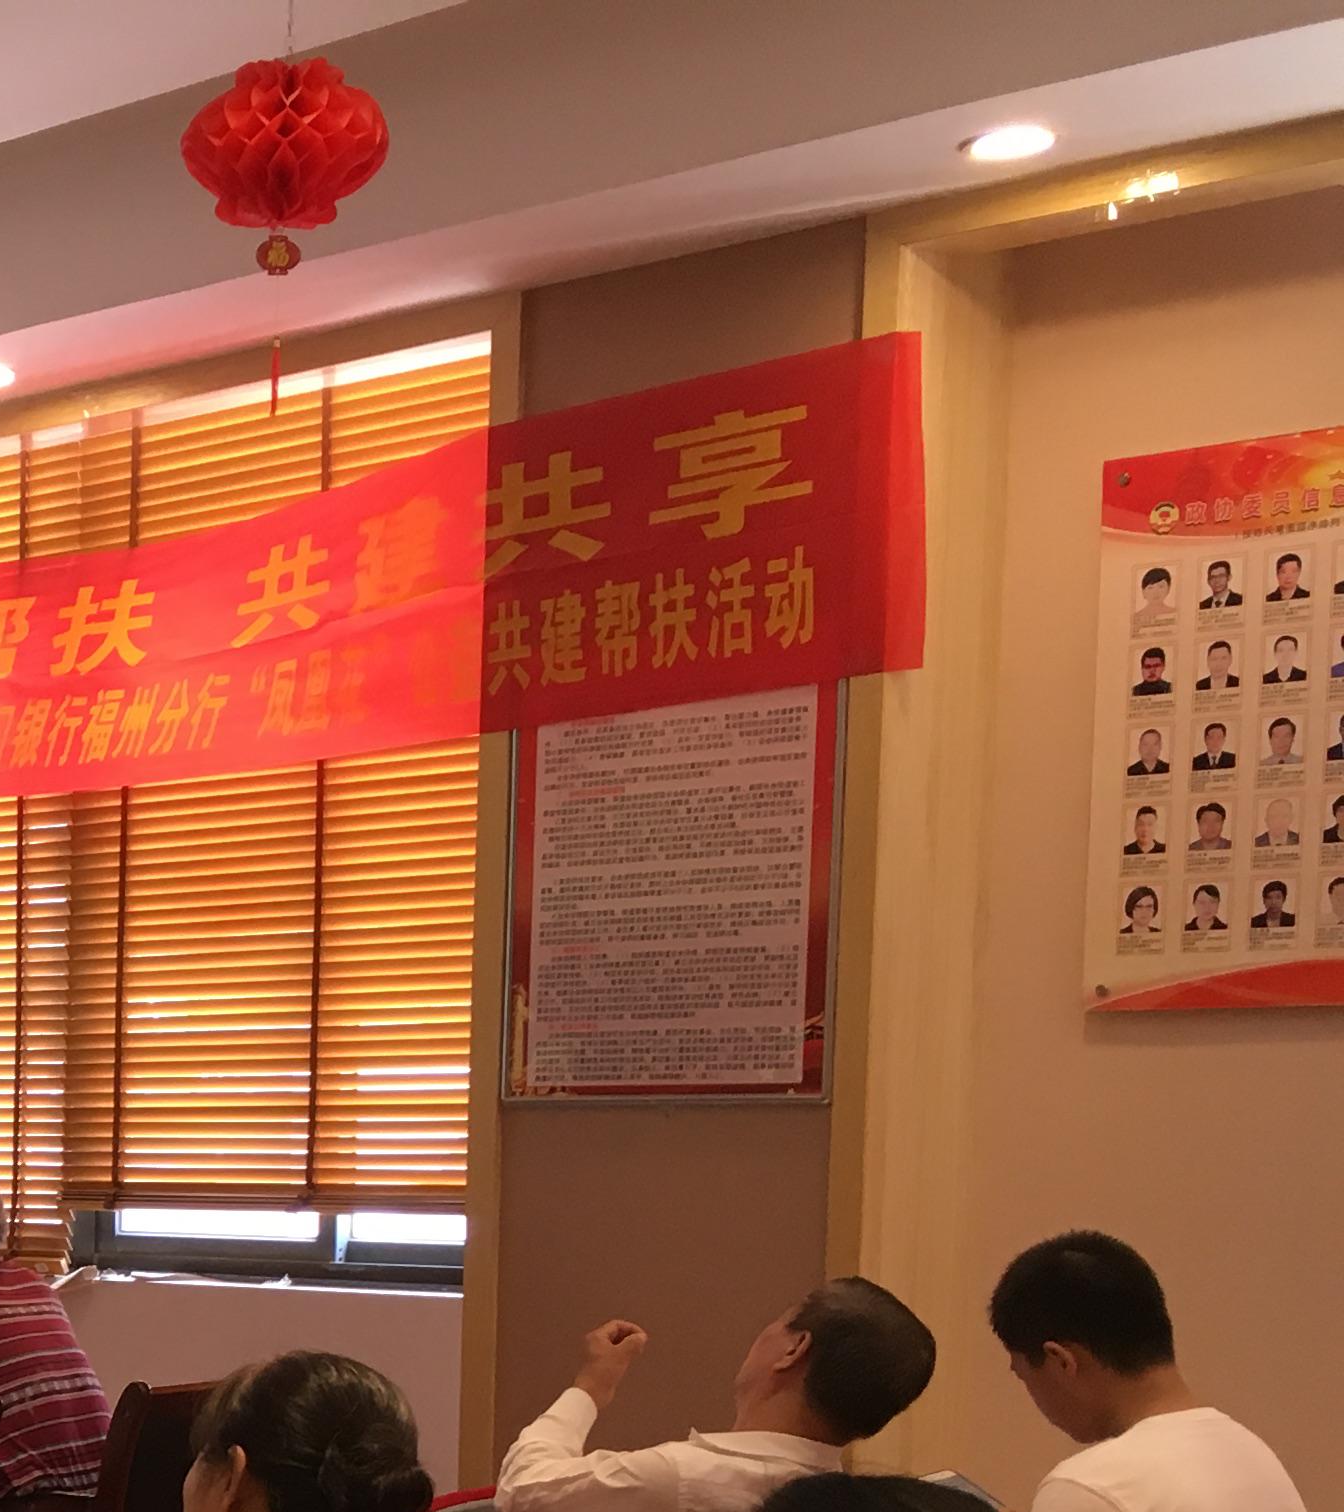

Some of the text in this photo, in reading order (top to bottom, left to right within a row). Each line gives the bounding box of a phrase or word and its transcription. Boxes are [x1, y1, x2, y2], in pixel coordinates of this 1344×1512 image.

[486, 544, 813, 697] 共建帮扶活动
